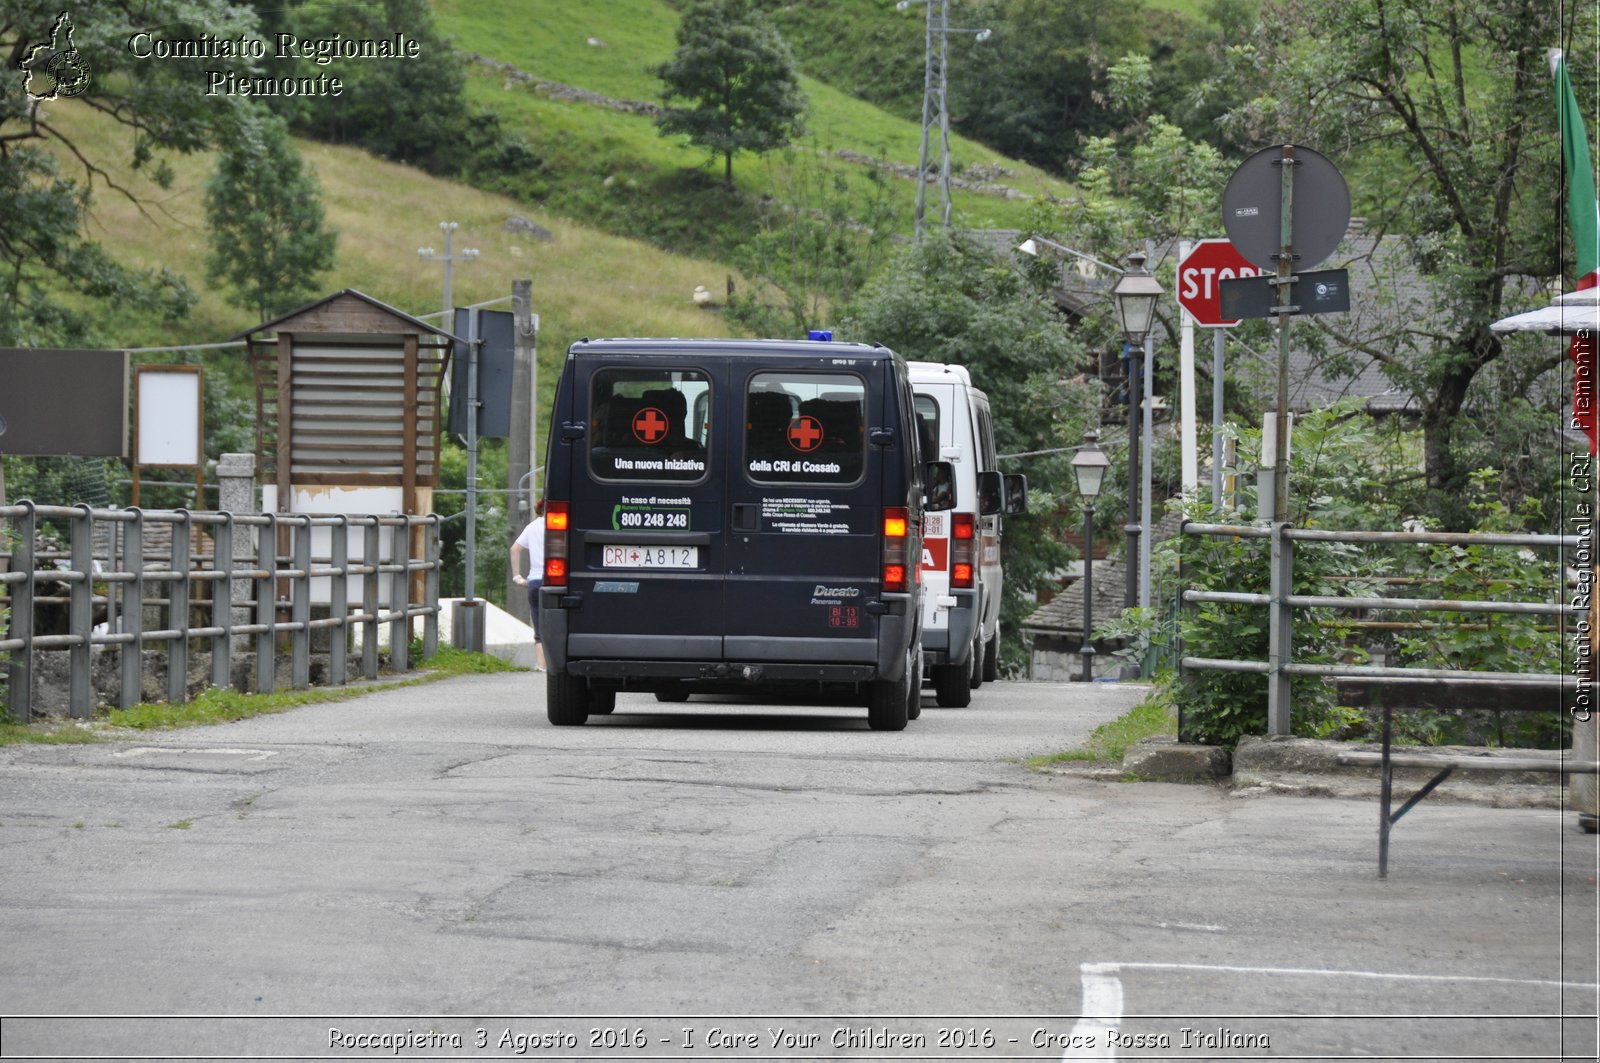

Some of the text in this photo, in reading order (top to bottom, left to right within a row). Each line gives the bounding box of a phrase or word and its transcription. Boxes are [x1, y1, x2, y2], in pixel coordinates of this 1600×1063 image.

[1182, 267, 1256, 299] ST
[614, 457, 705, 471] Una nuova iniziativa
[749, 460, 840, 473] della CRI di Cossato
[621, 496, 692, 506] In caso di necessità
[621, 512, 688, 528] 800 248 248
[605, 548, 627, 565] CRI
[813, 585, 860, 597] Ducato
